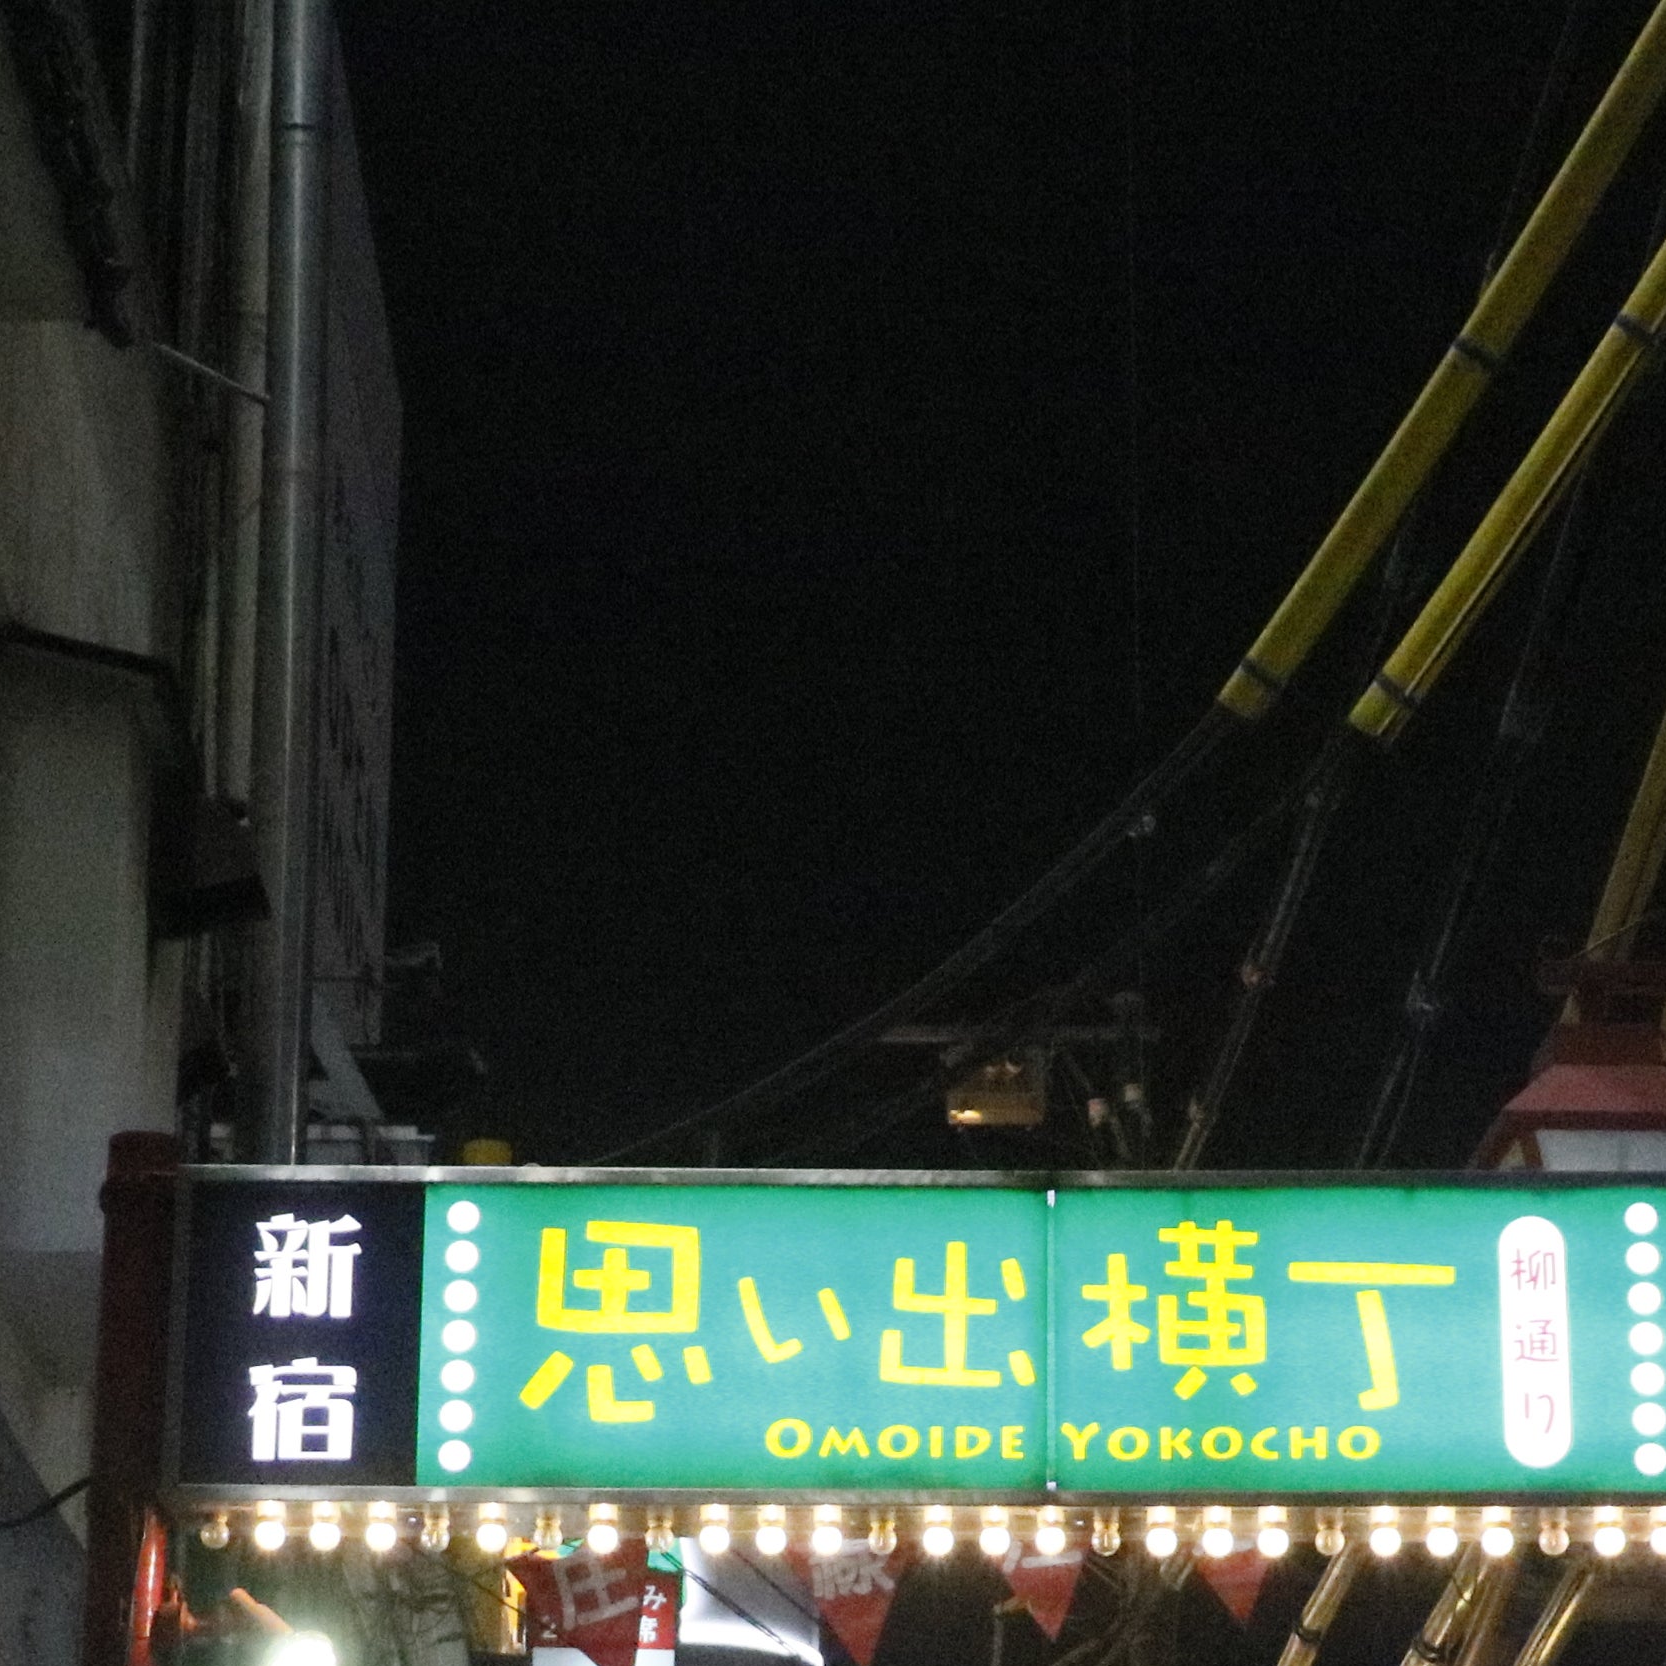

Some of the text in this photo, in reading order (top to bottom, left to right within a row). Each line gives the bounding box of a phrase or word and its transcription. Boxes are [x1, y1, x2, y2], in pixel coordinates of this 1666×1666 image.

[246, 1213, 363, 1463] 新宿
[519, 1219, 1456, 1424] 思い出横丁
[1508, 1246, 1560, 1434] 柳通り
[765, 1418, 1381, 1461] OMOIDE YOKOCHO
